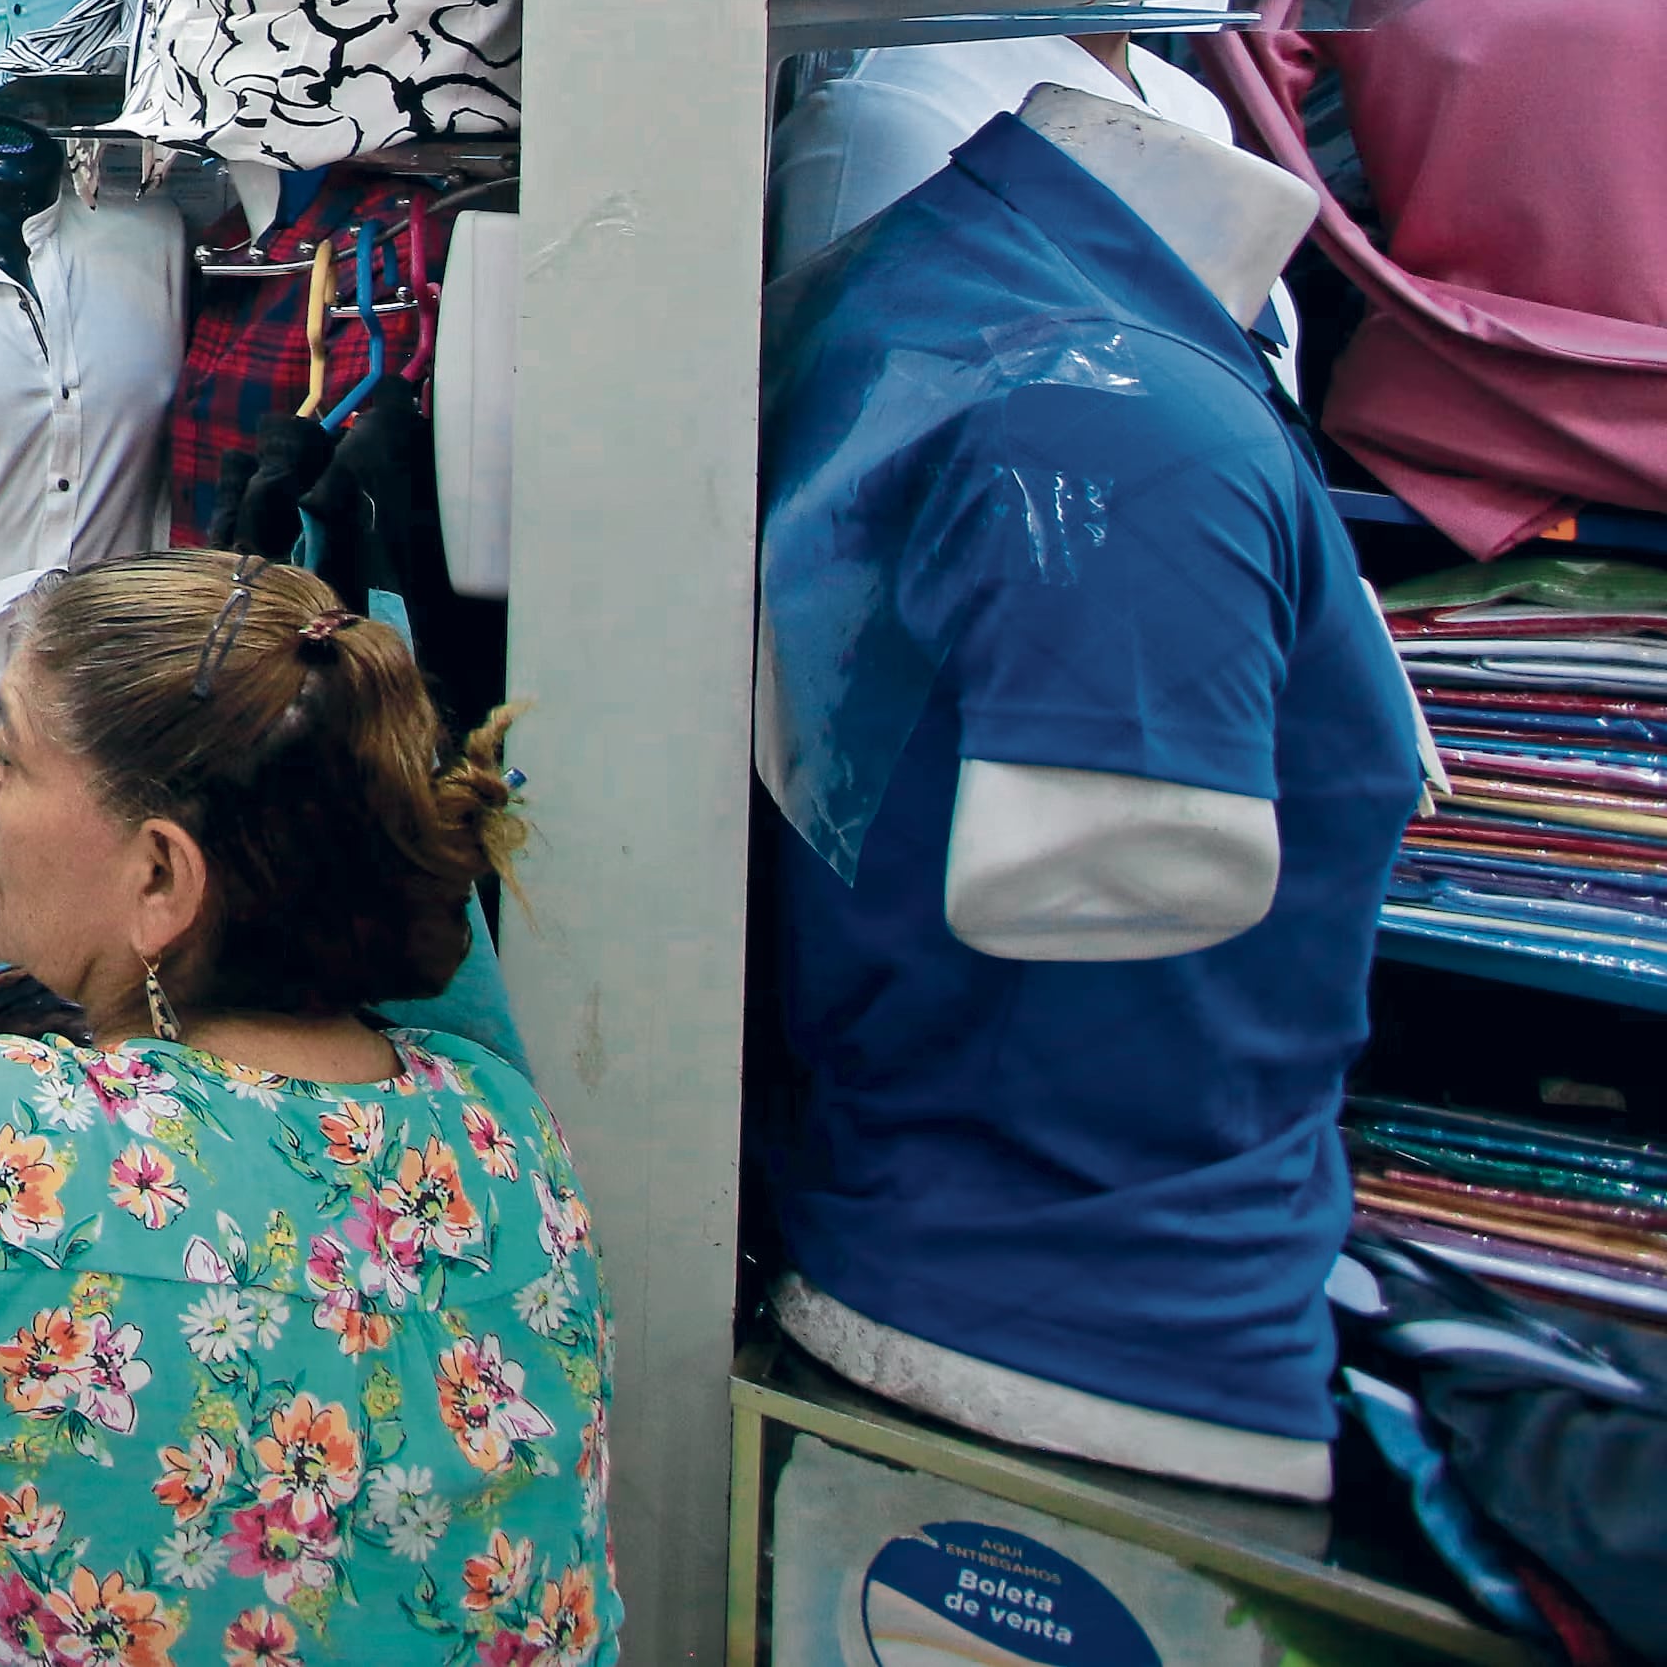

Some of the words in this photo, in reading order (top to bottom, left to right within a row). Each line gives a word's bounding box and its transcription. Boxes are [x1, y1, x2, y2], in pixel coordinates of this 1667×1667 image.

[945, 1542, 1062, 1585] ENTREGAMOS
[958, 1568, 1053, 1614] Boleta
[944, 1590, 980, 1616] de
[989, 1605, 1074, 1645] venta
